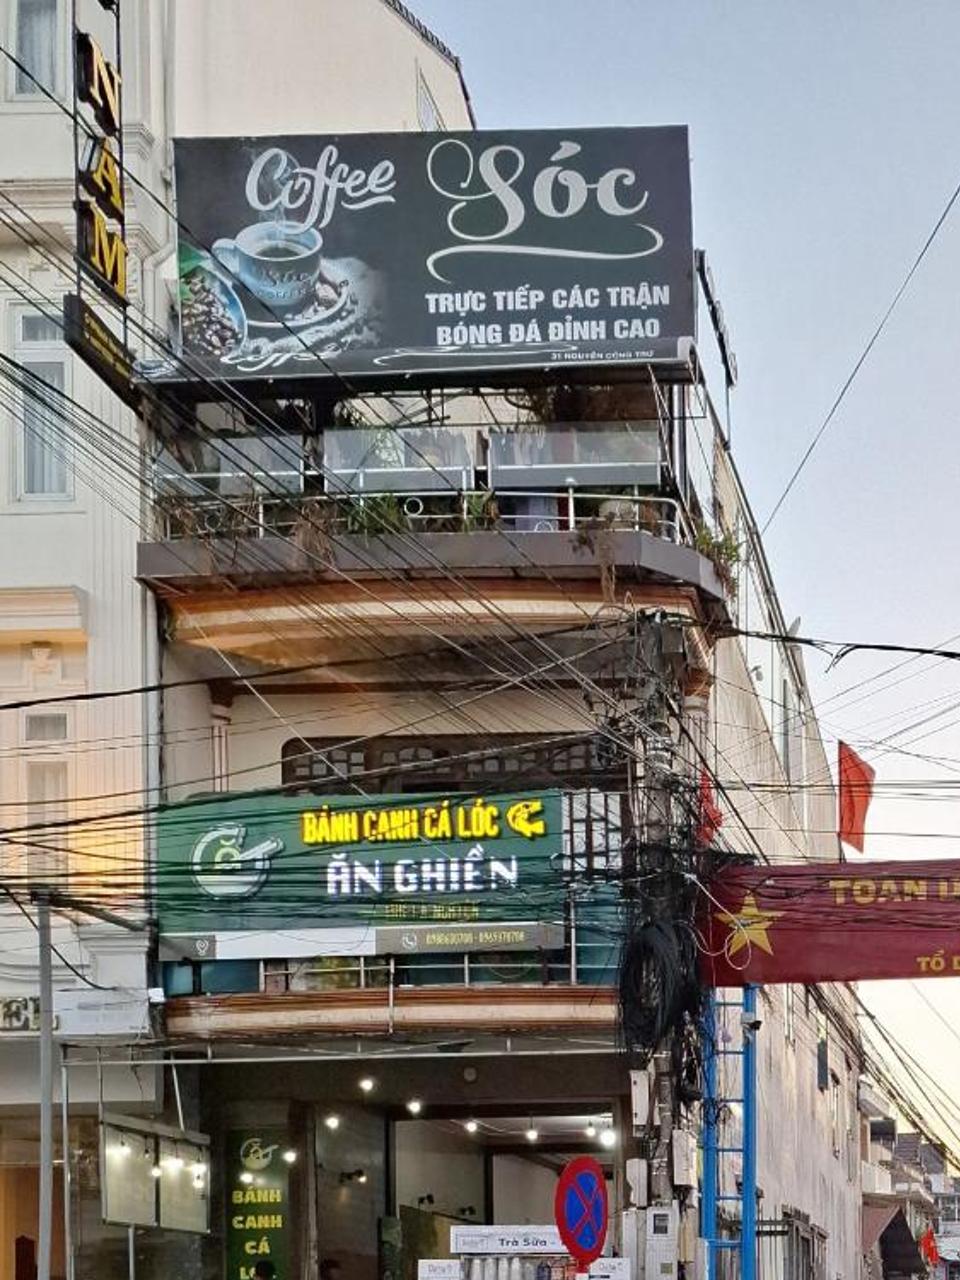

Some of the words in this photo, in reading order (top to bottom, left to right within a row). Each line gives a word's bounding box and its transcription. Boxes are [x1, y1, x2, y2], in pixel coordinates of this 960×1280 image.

[246, 144, 396, 234] Coffee
[427, 139, 648, 241] Sóc
[425, 290, 486, 316] TRỰC
[493, 284, 545, 311] TIẾP
[552, 285, 600, 309] CÁC
[607, 282, 670, 310] TRẬN
[437, 321, 502, 346] BÓNG
[509, 319, 542, 343] ĐÁ
[549, 315, 607, 341] ĐỈNH
[614, 318, 661, 339] CAO
[302, 805, 358, 843] BÁNH
[363, 810, 418, 841] CANH
[424, 800, 451, 839] CÁ
[326, 852, 383, 895] ĂN
[231, 1185, 282, 1204] BÁNH
[231, 1215, 283, 1229] CANH
[244, 1236, 271, 1255] CÁ
